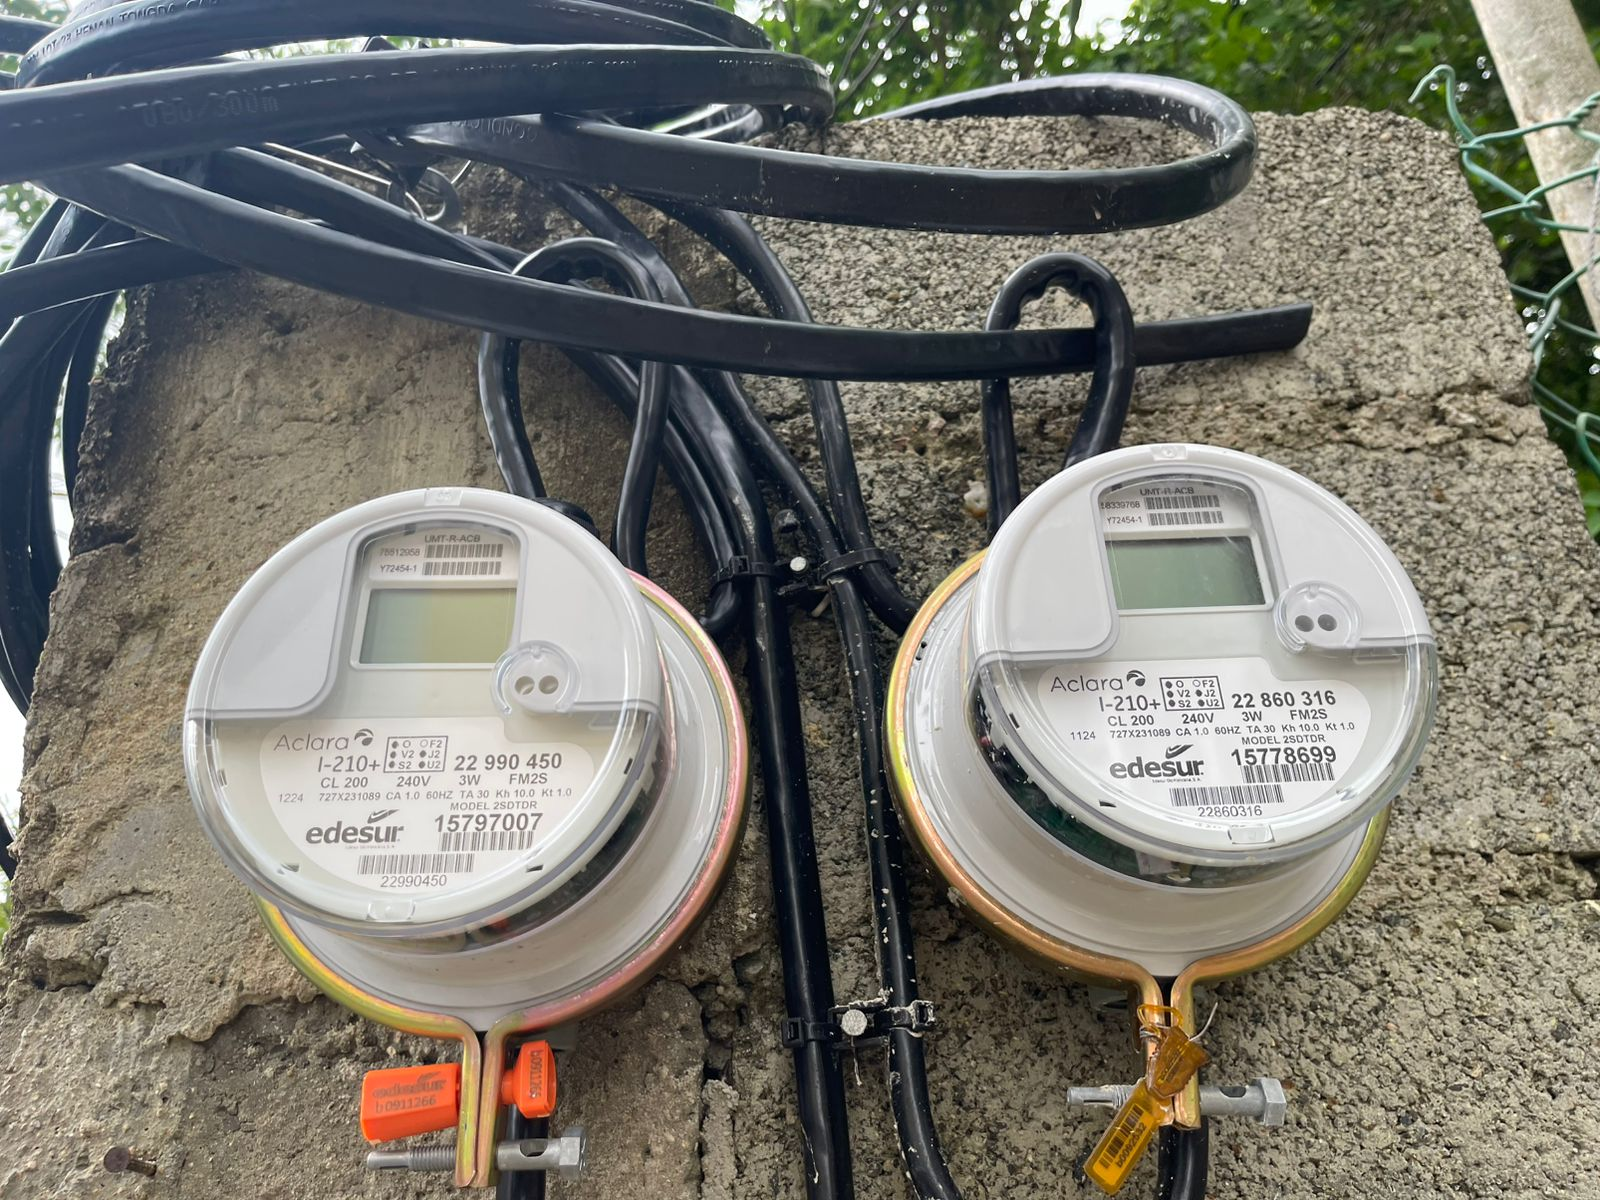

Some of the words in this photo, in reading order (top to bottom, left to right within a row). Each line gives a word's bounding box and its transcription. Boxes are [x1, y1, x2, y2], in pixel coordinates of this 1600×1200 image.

[75, 17, 114, 40] HENAN
[1140, 487, 1195, 496] UMT-R-ACB
[1107, 517, 1143, 525] Y72454-1
[424, 534, 481, 543] UMT-R-ACB
[380, 564, 417, 573] Y72454-1
[1050, 674, 1124, 693] Aclara
[1177, 689, 1191, 698] V2
[1204, 689, 1216, 698] J2
[1231, 693, 1255, 709] 22
[1261, 692, 1294, 708] 860
[1301, 690, 1336, 706] 316
[1100, 695, 1162, 712] I-210+
[1178, 699, 1192, 708] S2
[1206, 698, 1220, 707] U2
[1108, 715, 1127, 727] CL
[1131, 714, 1154, 726] 200
[1182, 713, 1215, 724] 240V
[1242, 711, 1263, 723] 3W
[1290, 709, 1328, 721] FM2S
[1070, 731, 1096, 741] 1124
[1110, 728, 1171, 739] 727X231089
[1175, 728, 1191, 737] CA
[1194, 727, 1209, 737] 1.0
[1215, 726, 1241, 735] 60HZ
[1246, 725, 1261, 734] TA
[1263, 724, 1276, 733] 30
[1282, 723, 1296, 733] Kh
[1299, 723, 1320, 732] 10.0
[1326, 722, 1338, 731] Kt
[1341, 721, 1355, 731] 1.0
[274, 733, 349, 752] Aclara
[1241, 736, 1280, 746] MODEL
[1283, 734, 1326, 744] 2SDTDR
[401, 750, 415, 759] V2
[428, 750, 441, 759] J2
[454, 755, 478, 771] 22
[485, 754, 520, 770] 990
[526, 752, 562, 769] 450
[1231, 746, 1337, 766] 15778699
[318, 756, 381, 773] I-210+
[398, 761, 412, 770] S2
[427, 760, 441, 769] U2
[1109, 756, 1204, 779] edesur
[320, 777, 340, 789] CL
[344, 776, 368, 788] 200
[396, 776, 431, 787] 240V
[459, 774, 481, 786] 3W
[509, 773, 548, 785] FM2S
[278, 793, 304, 803] 1224
[319, 791, 381, 802] 727X231089
[386, 791, 401, 800] CA
[405, 790, 420, 800] 1.0
[426, 790, 453, 800] 60HZ
[460, 789, 474, 799] TA
[476, 789, 490, 799] 30
[496, 788, 510, 798] Kh
[514, 788, 535, 798] 10.0
[541, 788, 553, 797] Kt
[556, 787, 572, 797] 1.0
[450, 801, 491, 811] MODEL
[493, 800, 538, 810] 2SDTDR
[1197, 805, 1263, 818] 22860316
[434, 812, 543, 833] 15797007
[305, 820, 404, 845] edesur
[380, 874, 447, 889] 22990450
